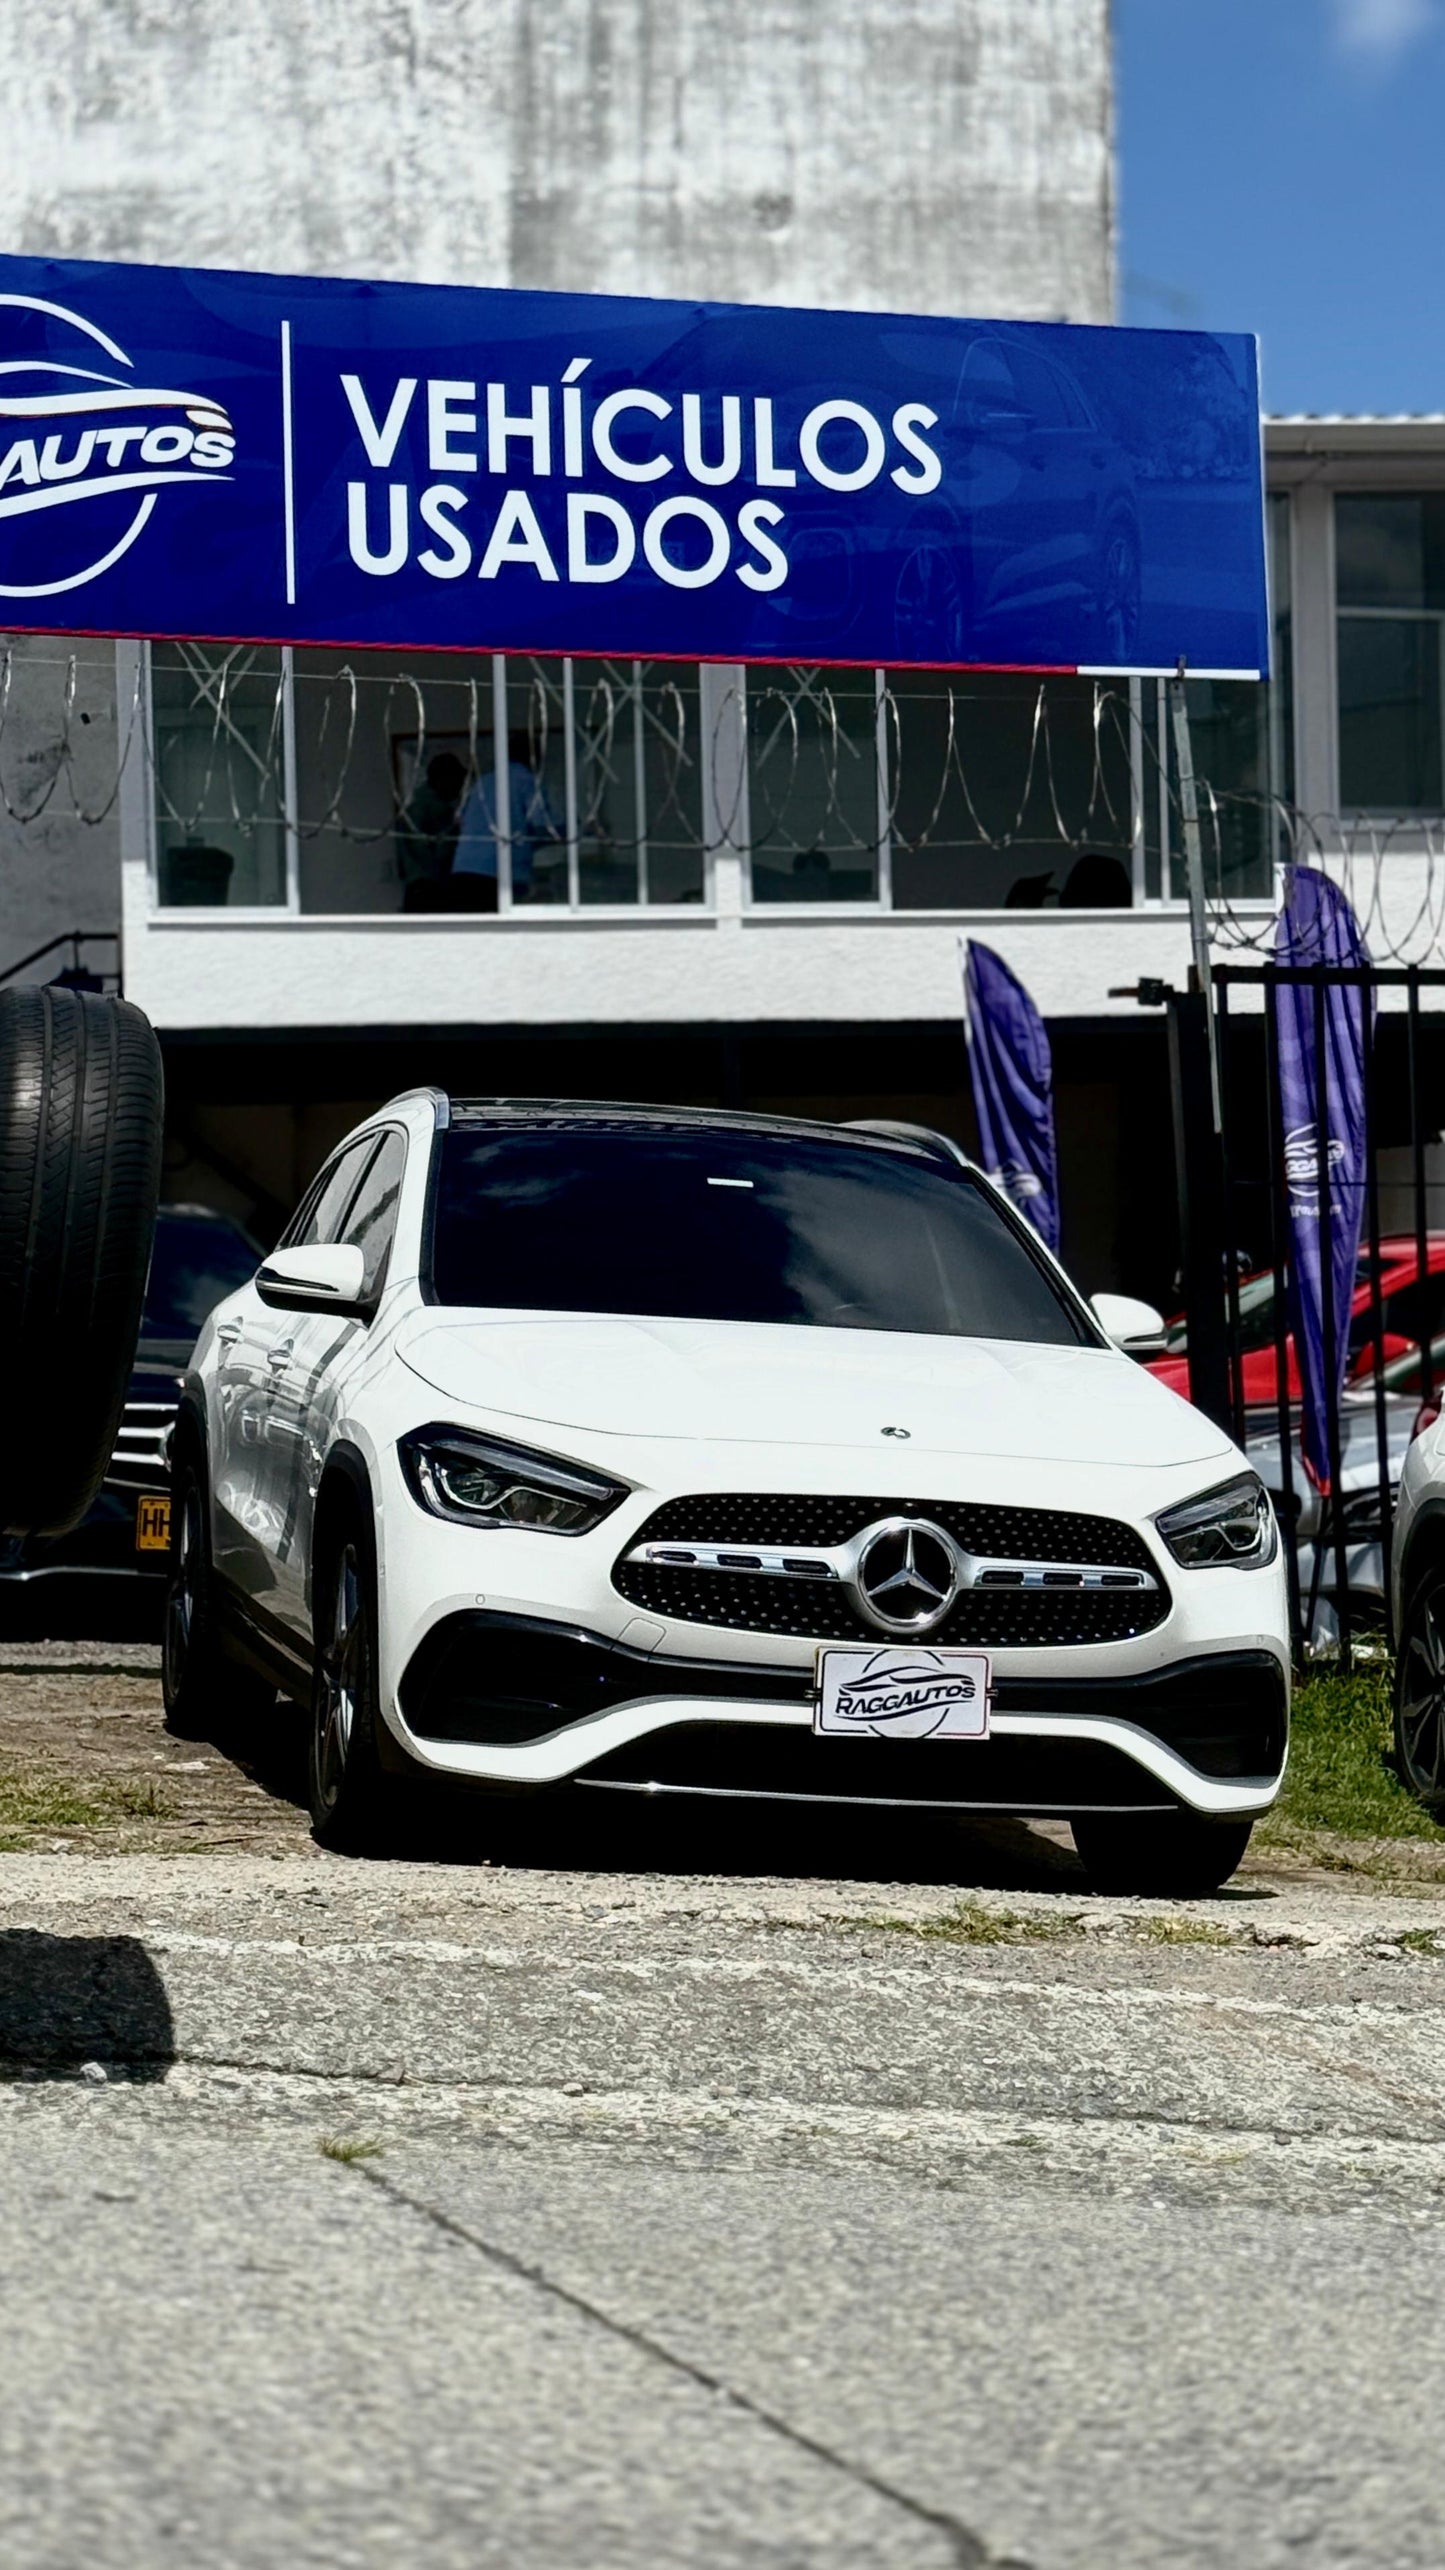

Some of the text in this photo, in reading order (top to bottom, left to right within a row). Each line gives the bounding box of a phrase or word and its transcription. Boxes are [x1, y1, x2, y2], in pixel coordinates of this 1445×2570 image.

[340, 358, 942, 495] VEHÍCULOS
[347, 481, 789, 592] USADOS
[834, 1685, 976, 1715] RAGGAUTOS
